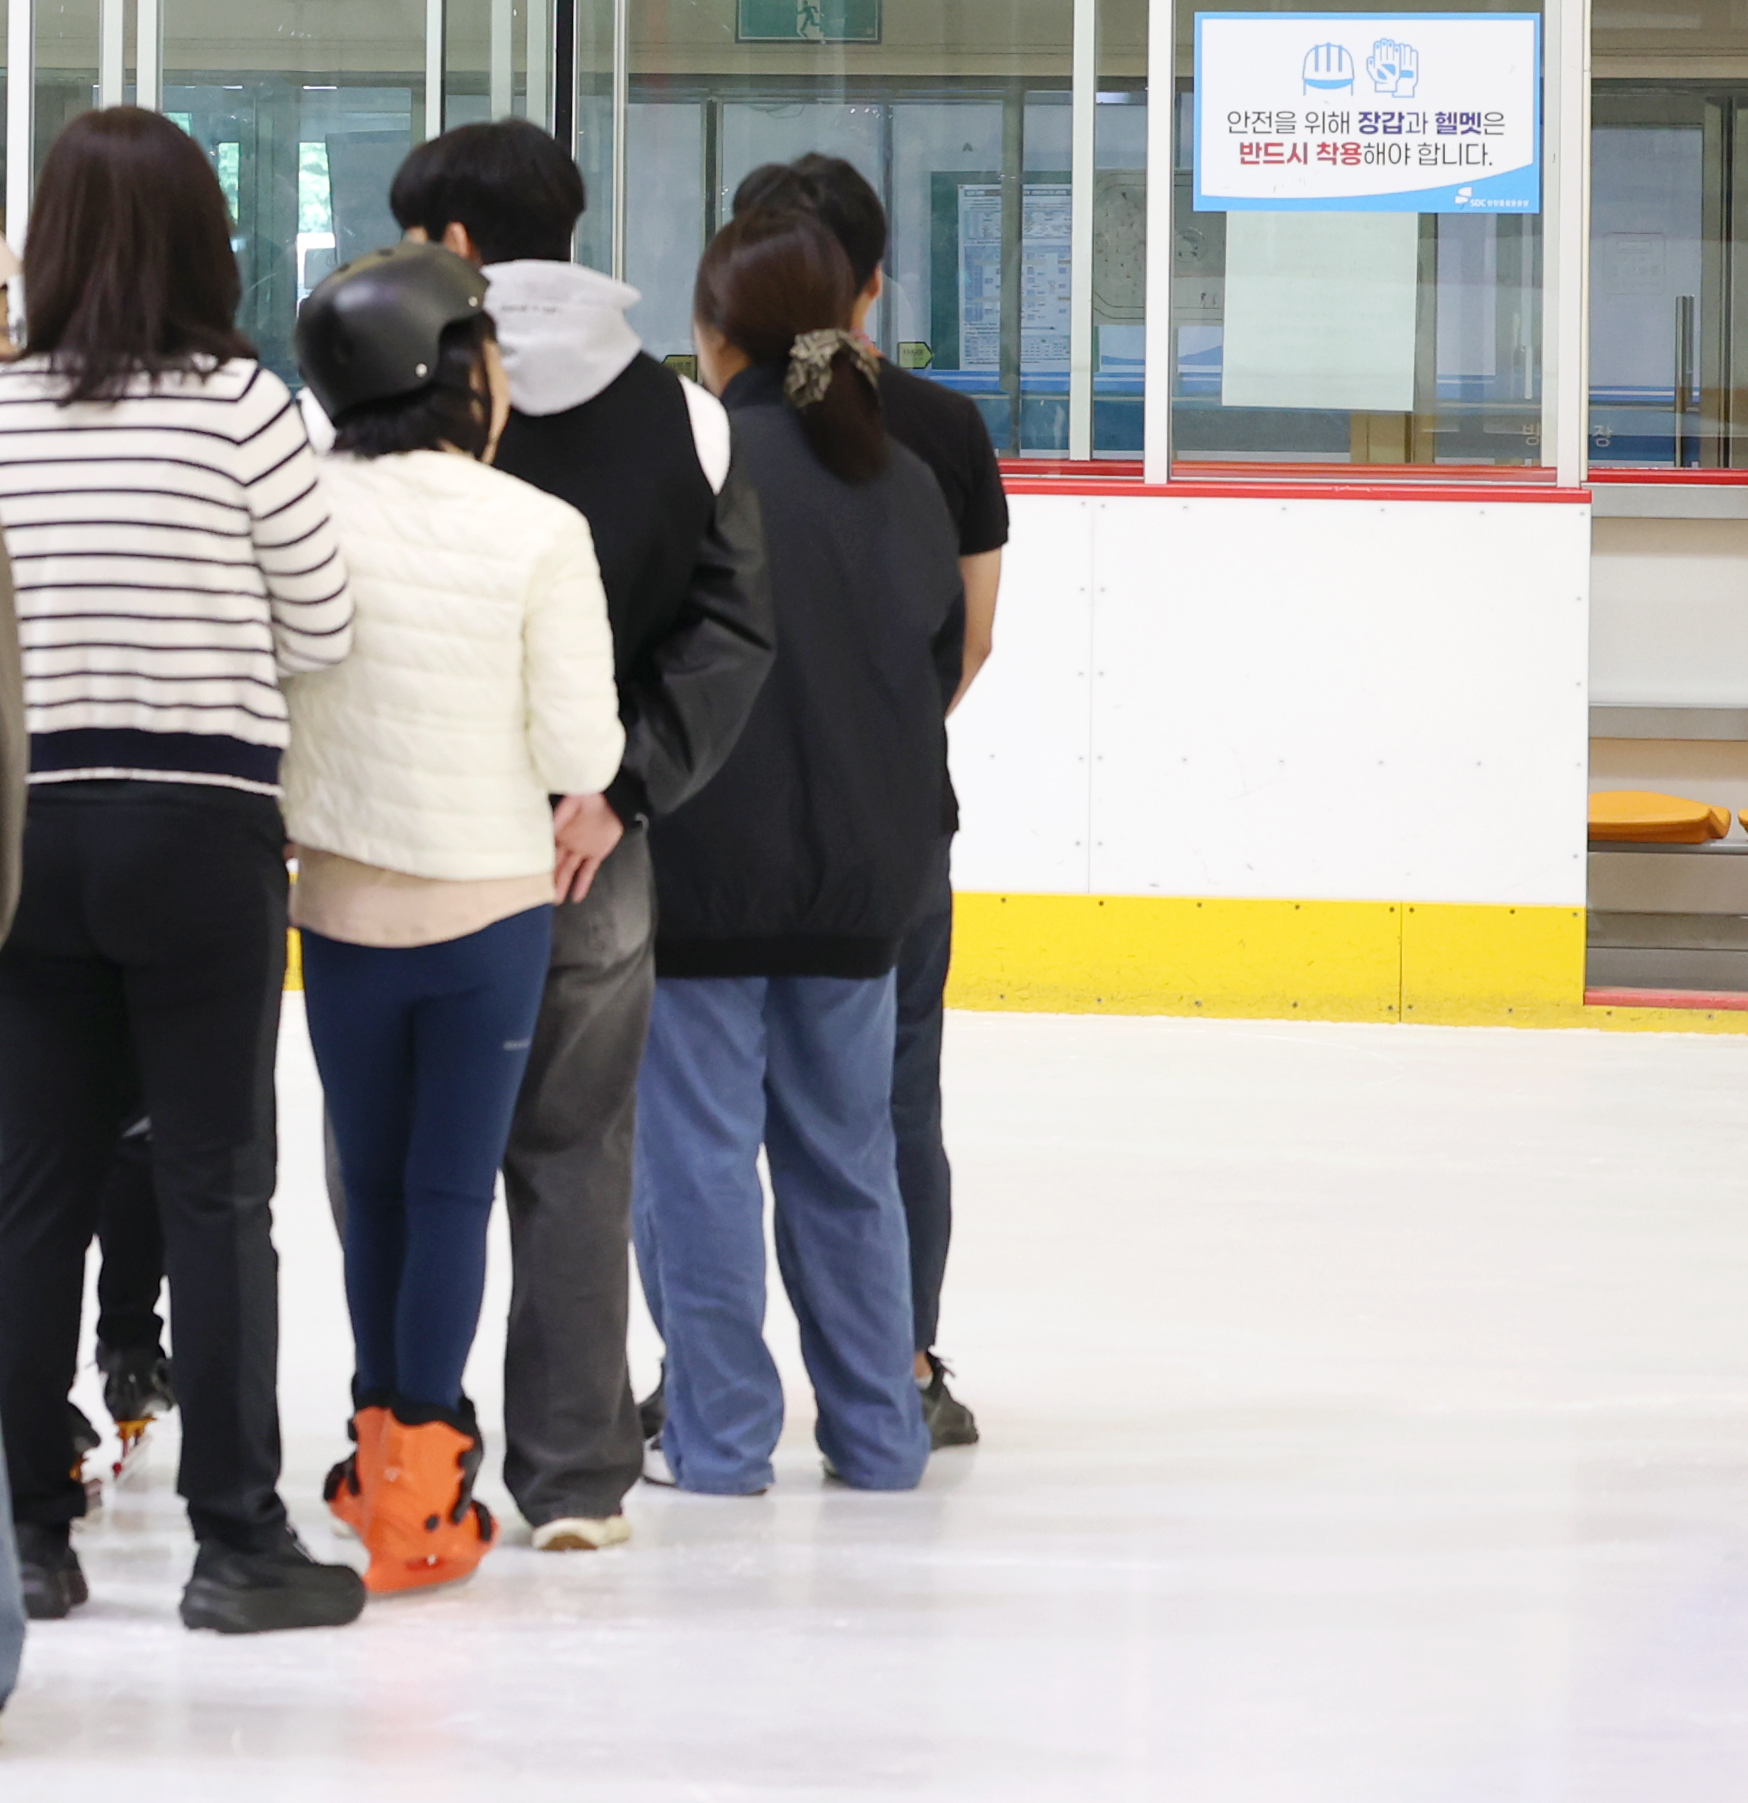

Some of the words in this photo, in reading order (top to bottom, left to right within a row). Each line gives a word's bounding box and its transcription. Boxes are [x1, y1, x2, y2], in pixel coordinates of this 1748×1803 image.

[1226, 110, 1297, 135] 안전을
[1304, 110, 1351, 135] 위해
[1357, 110, 1429, 136] 장갑과
[1434, 111, 1505, 136] 헬멧은
[1239, 142, 1308, 166] 반드시
[1316, 141, 1411, 167] 착용해야
[1417, 142, 1494, 167] 합니다.
